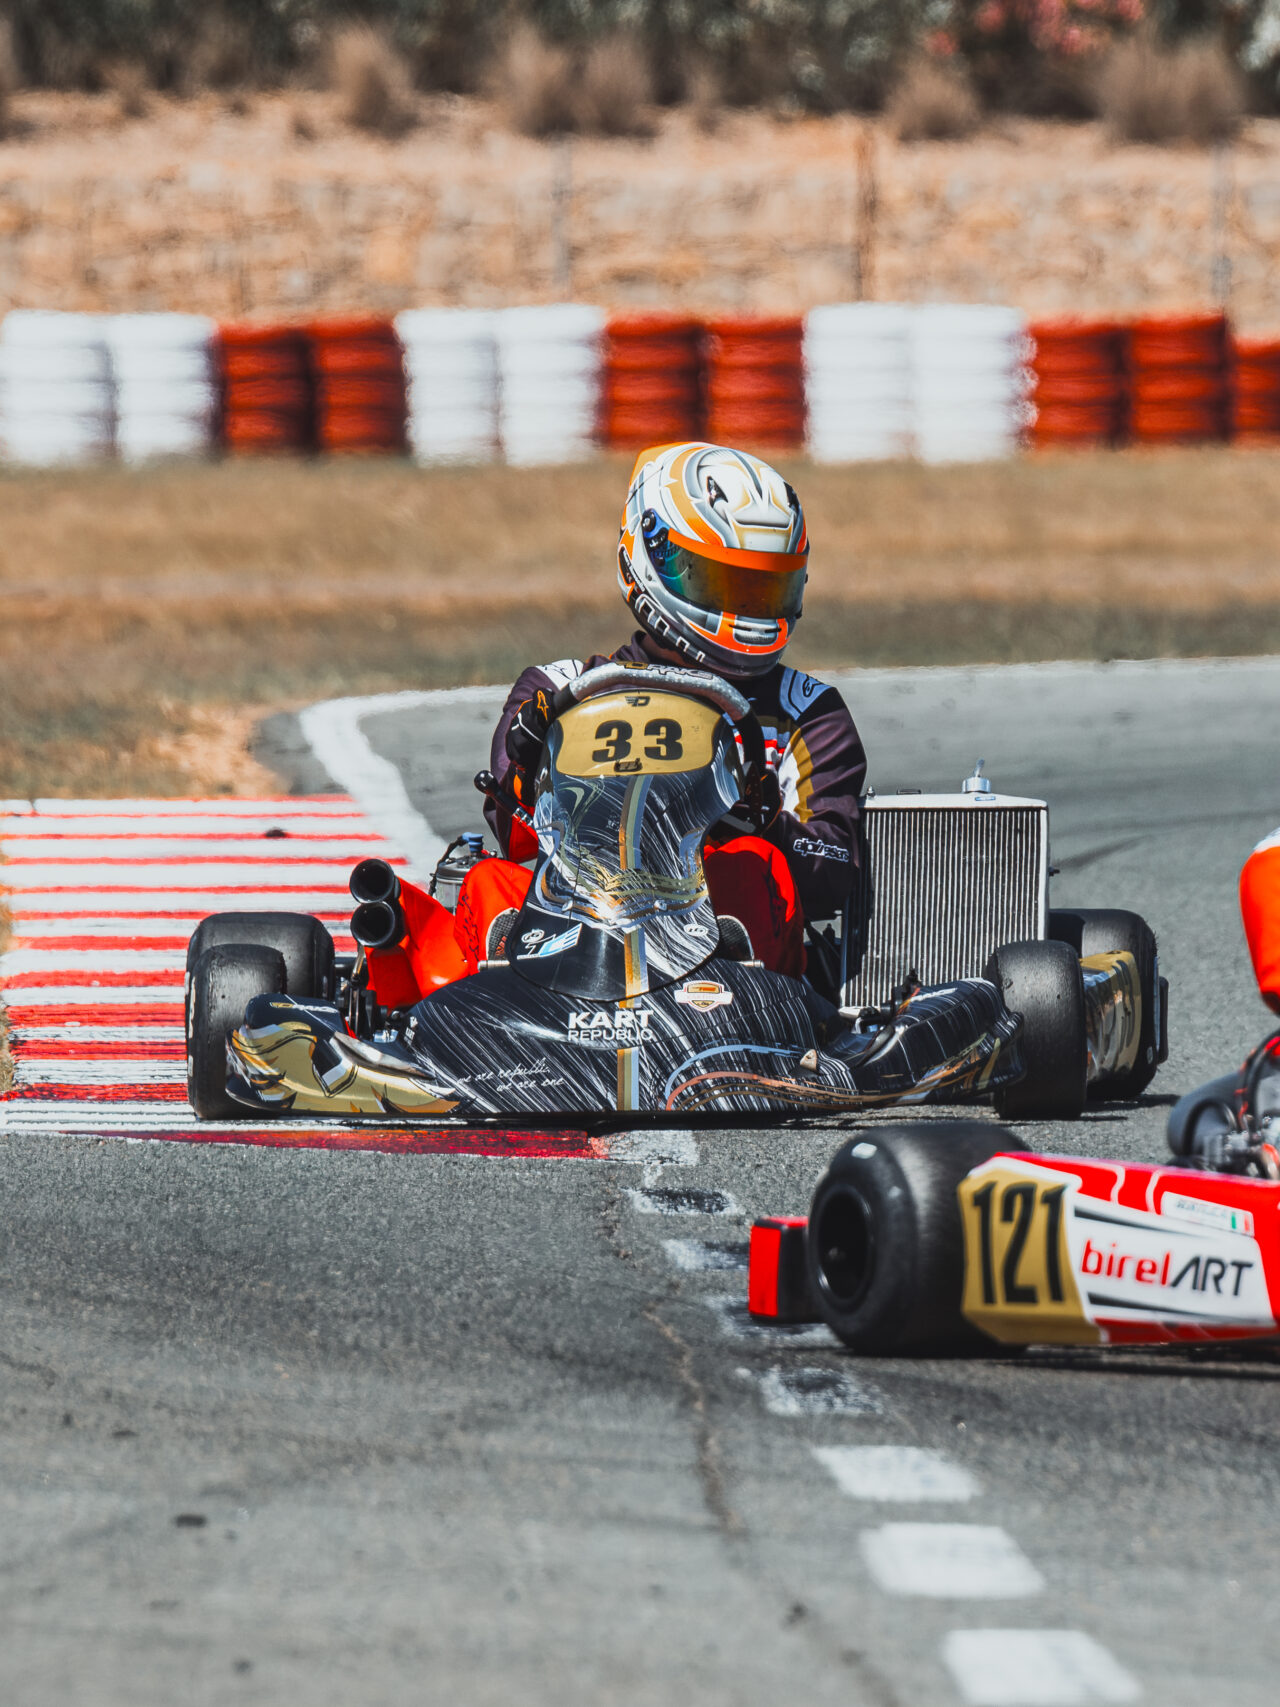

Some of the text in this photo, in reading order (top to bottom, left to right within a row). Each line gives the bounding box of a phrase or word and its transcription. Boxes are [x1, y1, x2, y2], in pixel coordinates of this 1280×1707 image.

[591, 718, 684, 762] 33
[568, 1009, 655, 1030] KART
[970, 1180, 1067, 1304] 121
[1081, 1238, 1255, 1297] birelART
